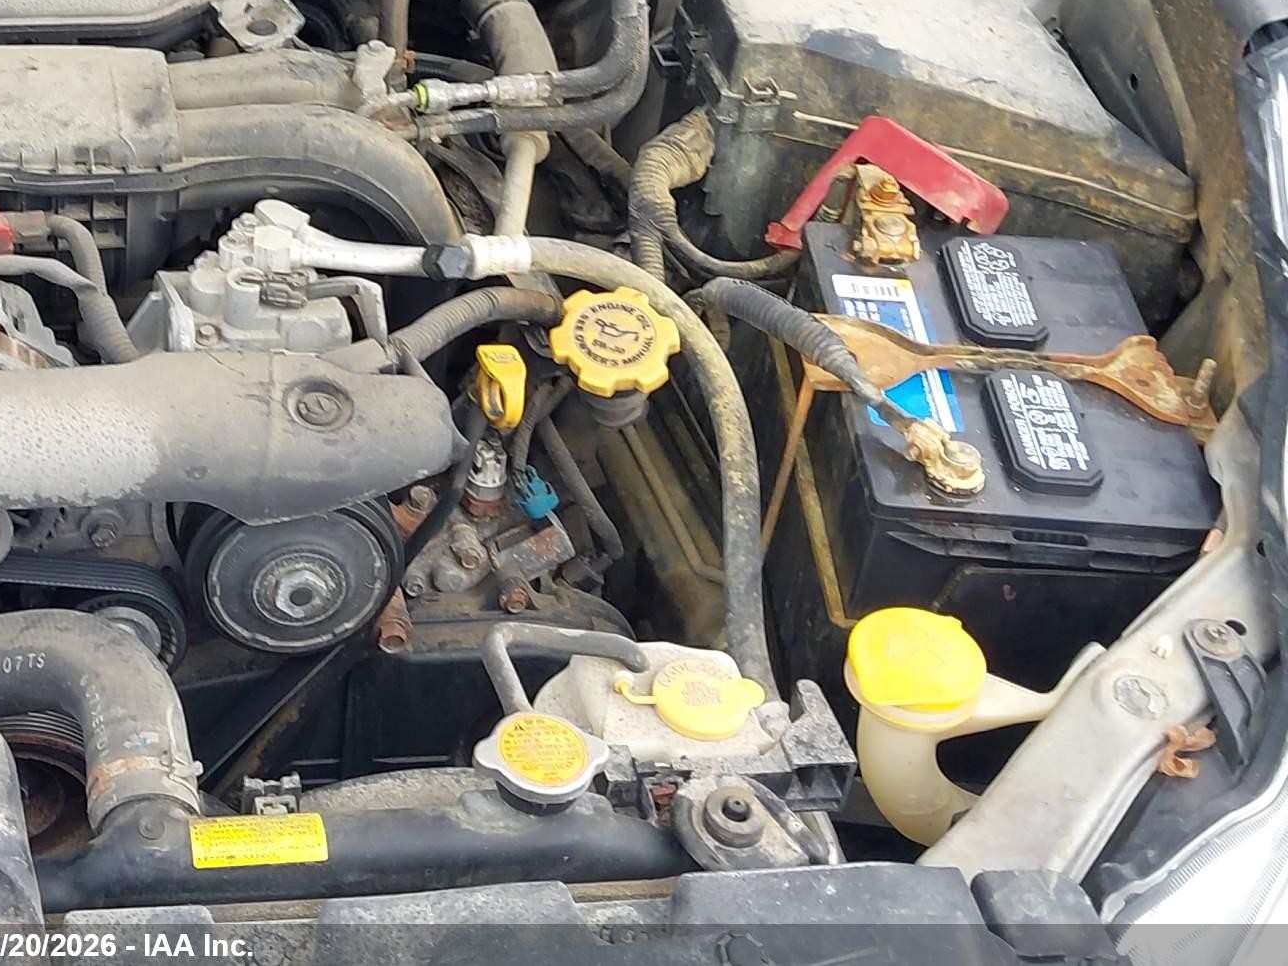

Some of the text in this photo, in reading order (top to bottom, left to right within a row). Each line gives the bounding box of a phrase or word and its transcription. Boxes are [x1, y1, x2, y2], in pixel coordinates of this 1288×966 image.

[590, 302, 651, 331] ENGINE OIL
[575, 314, 589, 331] SEE
[622, 336, 654, 365] MANUAL
